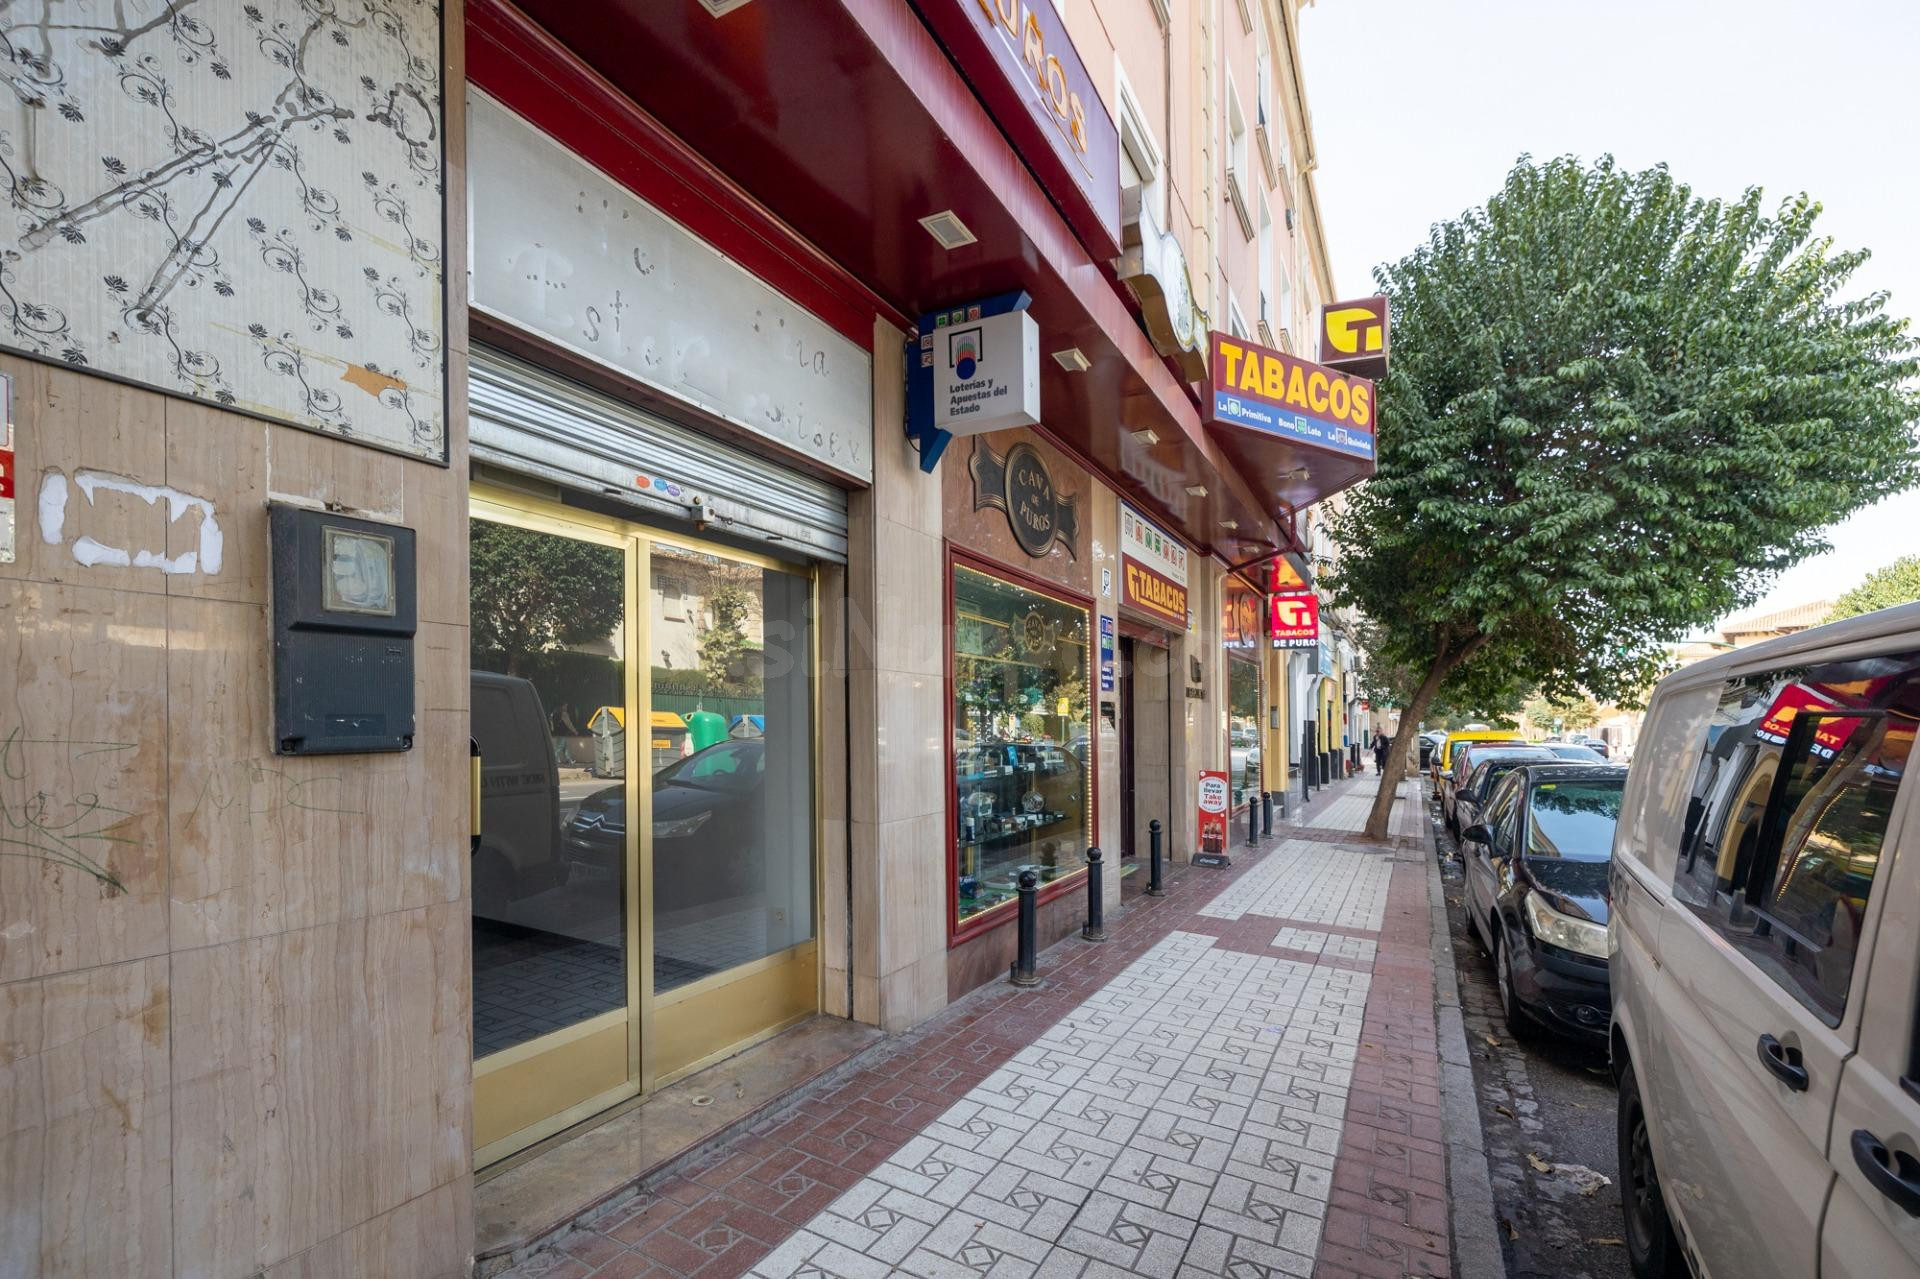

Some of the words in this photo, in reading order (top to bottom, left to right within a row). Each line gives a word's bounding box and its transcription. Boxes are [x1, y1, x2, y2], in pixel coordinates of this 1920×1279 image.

[974, 0, 1088, 153] UROS
[950, 379, 986, 394] Loterías
[988, 378, 994, 389] y
[950, 390, 991, 405] Apuestas
[993, 386, 1008, 396] del
[1220, 341, 1370, 426] TABACOS
[950, 404, 980, 416] Estado
[1218, 401, 1227, 412] La
[1241, 408, 1272, 424] Primitiva
[1278, 418, 1295, 430] Bono
[1307, 426, 1322, 437] Loto
[1018, 469, 1050, 500] CAVA
[1020, 501, 1050, 531] PUROS
[1139, 571, 1185, 613] TABACOS
